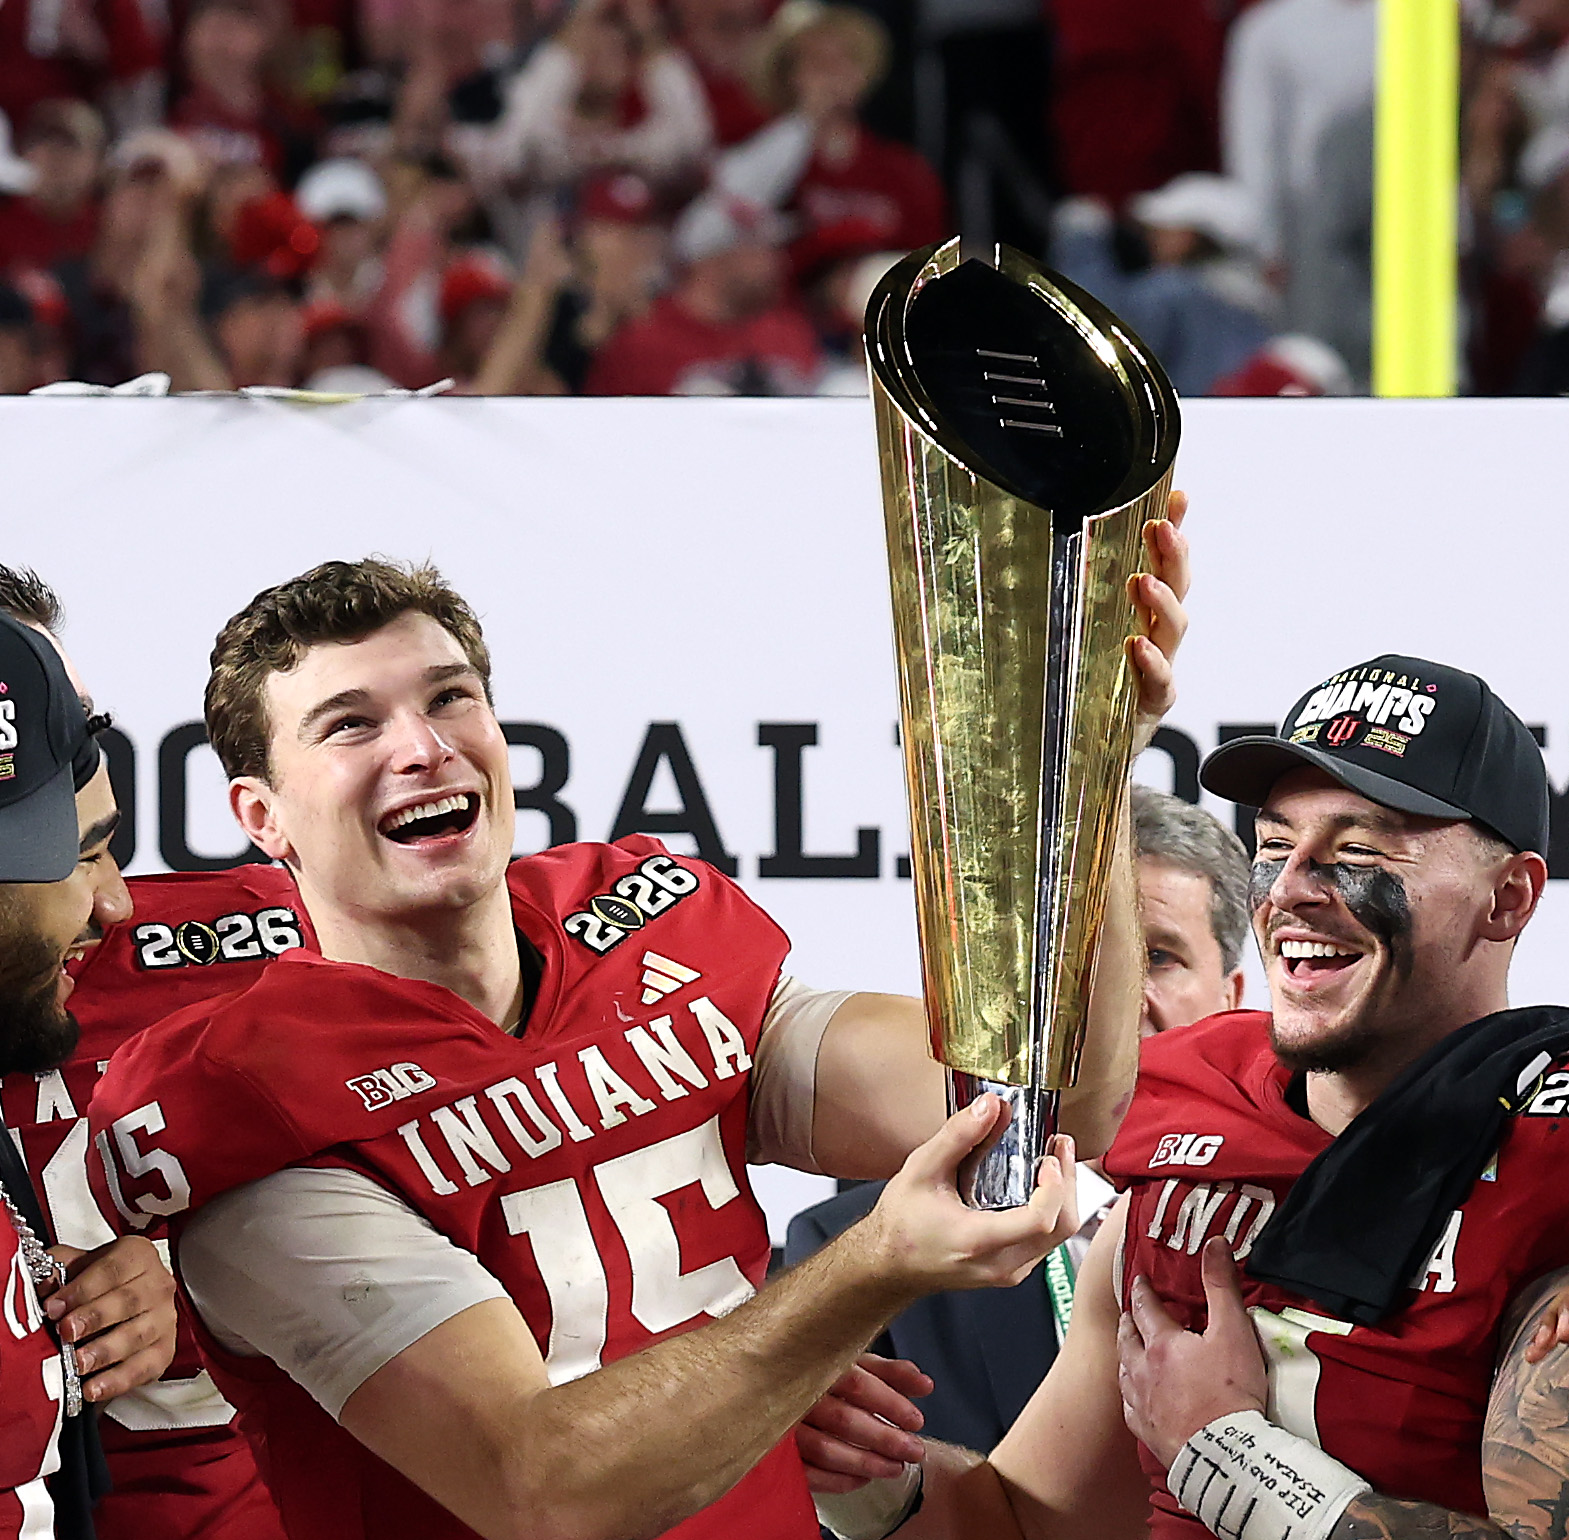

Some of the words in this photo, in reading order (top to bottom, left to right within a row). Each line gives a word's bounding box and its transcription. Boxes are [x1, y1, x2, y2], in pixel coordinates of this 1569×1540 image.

[1294, 680, 1436, 735] CHAMPS
[398, 995, 753, 1195] INDIANA
[94, 1100, 191, 1230] 15
[500, 1115, 757, 1388] 15
[1046, 1246, 1073, 1330] ATIONAL
[1263, 1452, 1326, 1505] ISAIAH
